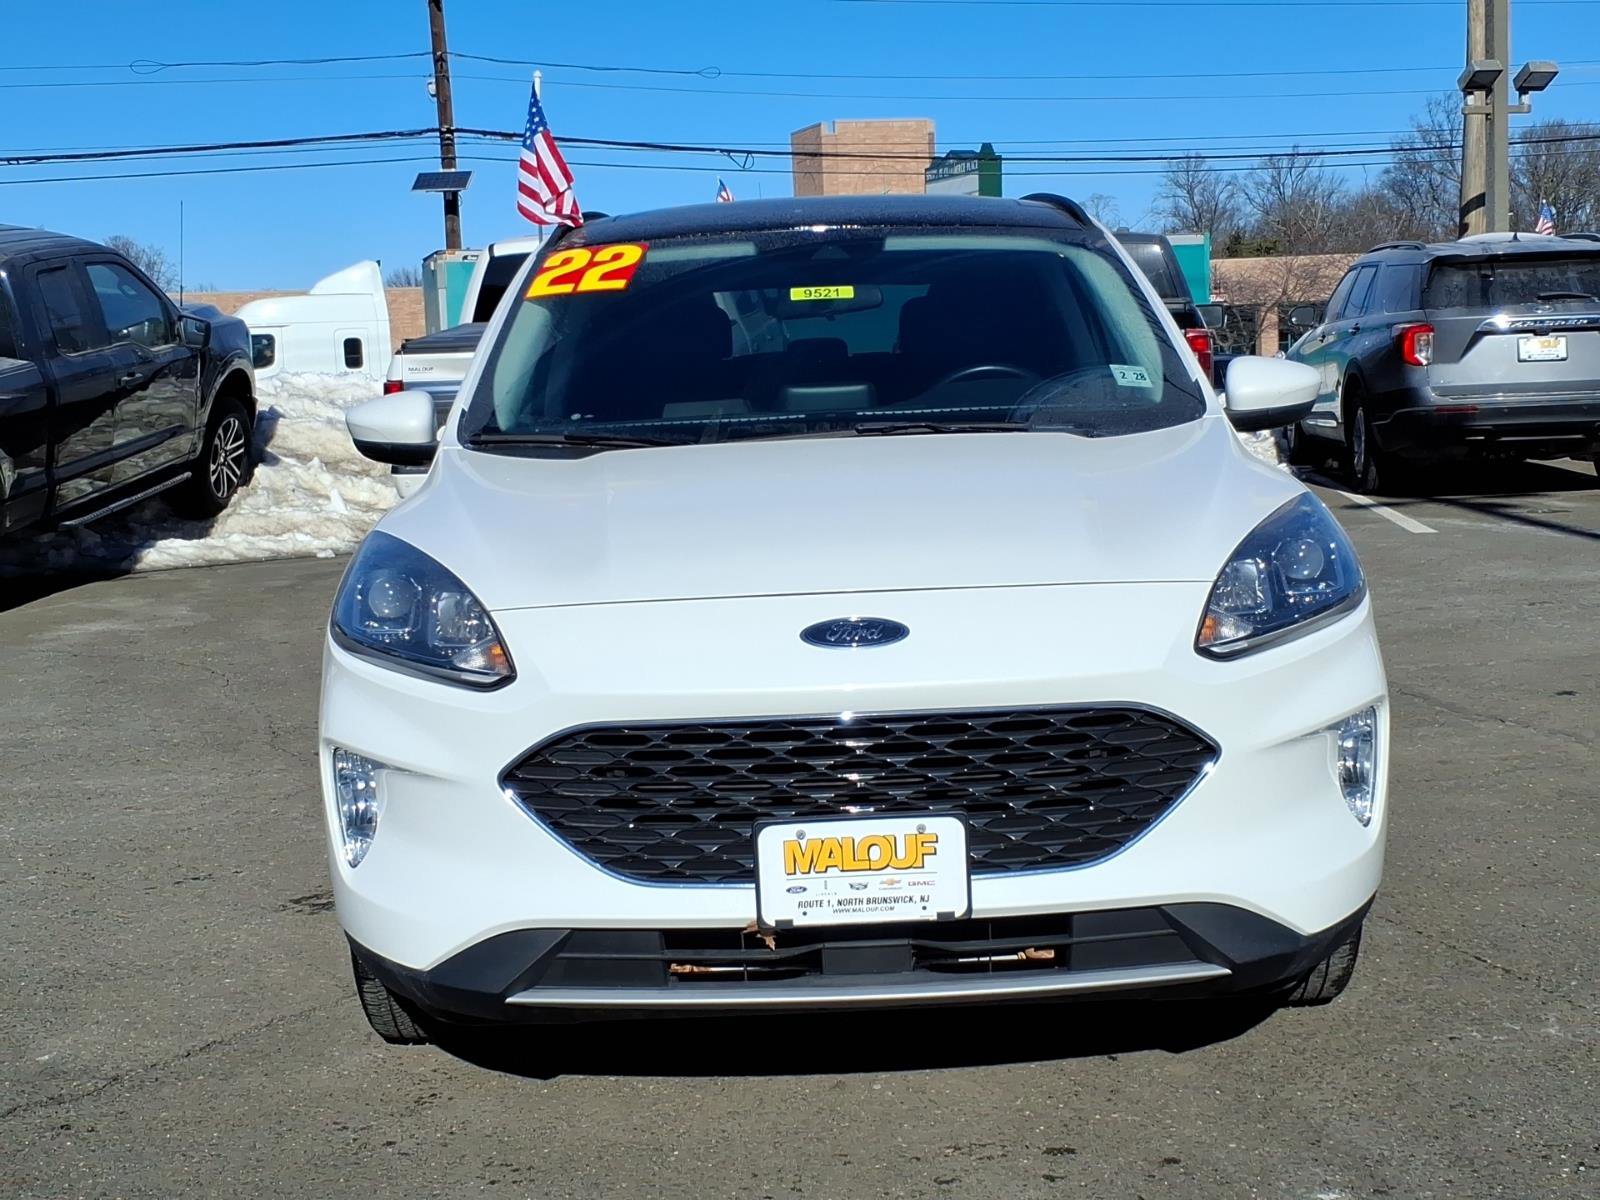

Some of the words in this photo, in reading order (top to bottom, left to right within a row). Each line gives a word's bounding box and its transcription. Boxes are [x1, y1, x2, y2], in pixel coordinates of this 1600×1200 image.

[526, 244, 643, 299] 22
[803, 288, 840, 298] 9521
[1119, 371, 1128, 380] 2
[1133, 372, 1147, 381] 28
[827, 621, 884, 641] Ford
[783, 832, 938, 875] MALOUF
[797, 899, 825, 909] ROUTE
[827, 899, 835, 908] 1,
[837, 897, 864, 907] NORTH
[866, 895, 917, 905] BRUNSWICK,
[920, 894, 930, 903] NJ
[832, 905, 895, 914] WWW.MALOUF.COM
